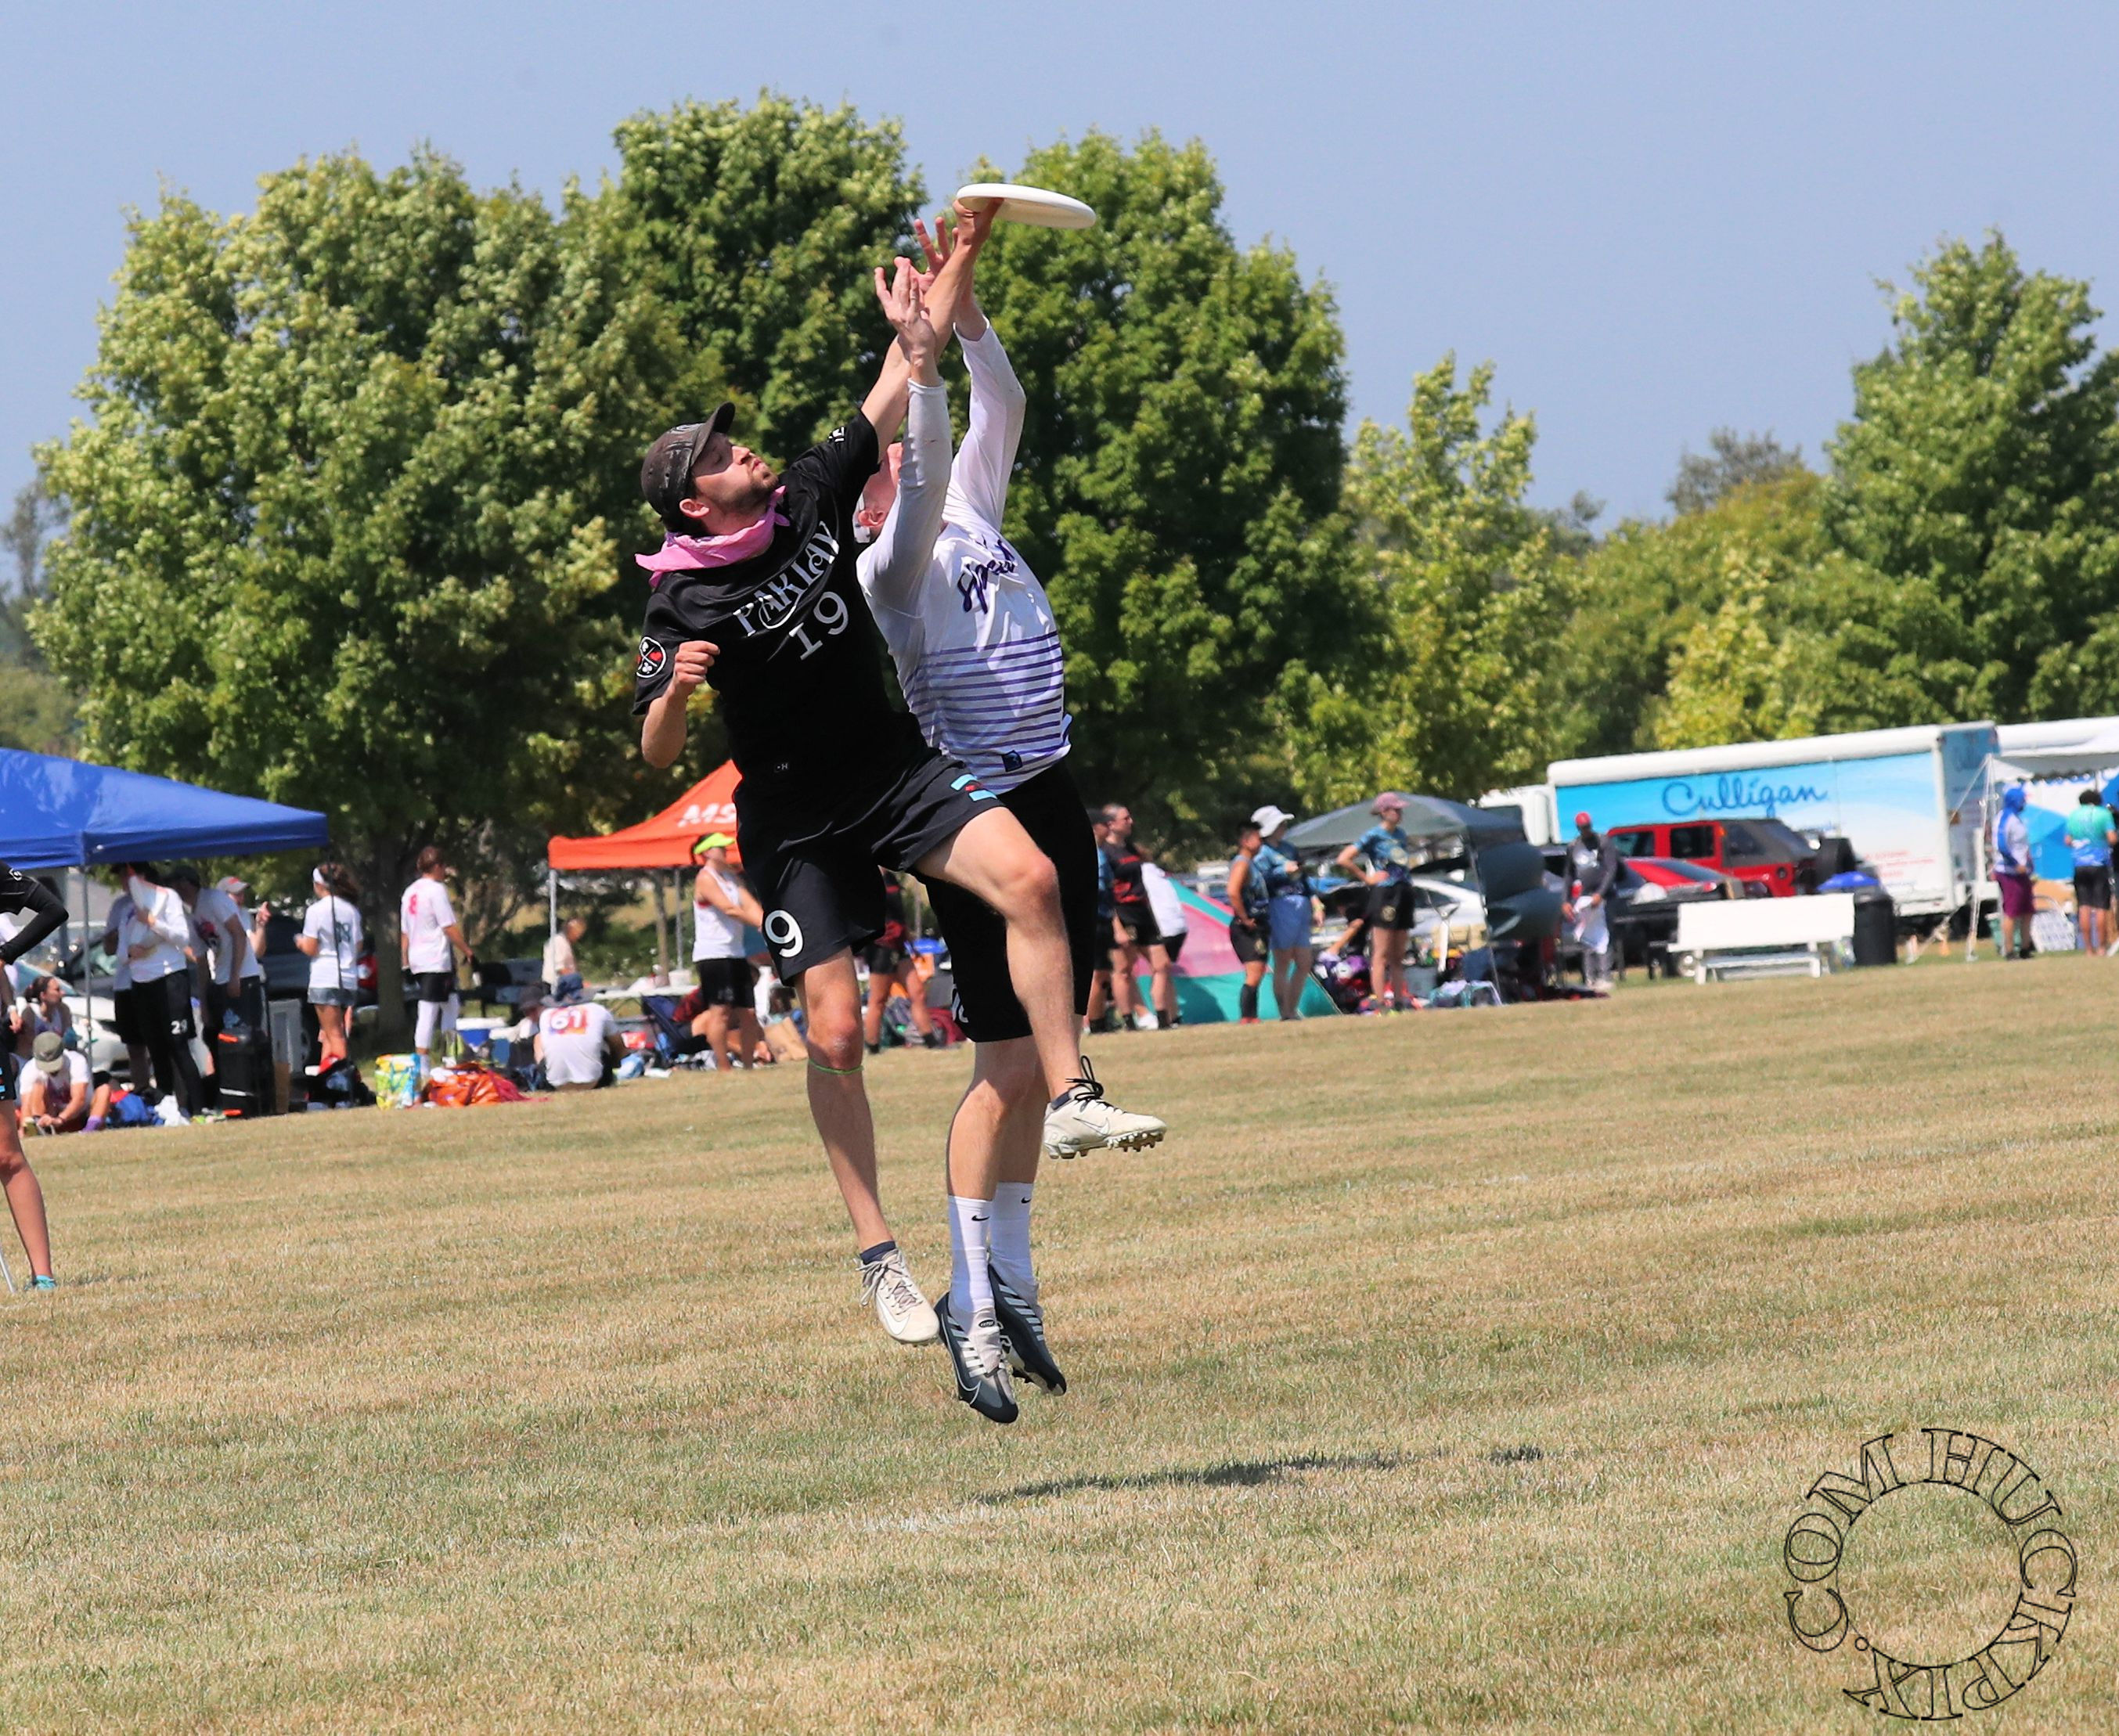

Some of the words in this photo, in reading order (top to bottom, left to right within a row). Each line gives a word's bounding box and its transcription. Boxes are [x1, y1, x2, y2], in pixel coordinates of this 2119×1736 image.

[733, 520, 839, 637] PARLAY
[788, 591, 849, 661] 19
[1662, 773, 1829, 818] Culligan
[764, 909, 803, 958] 9
